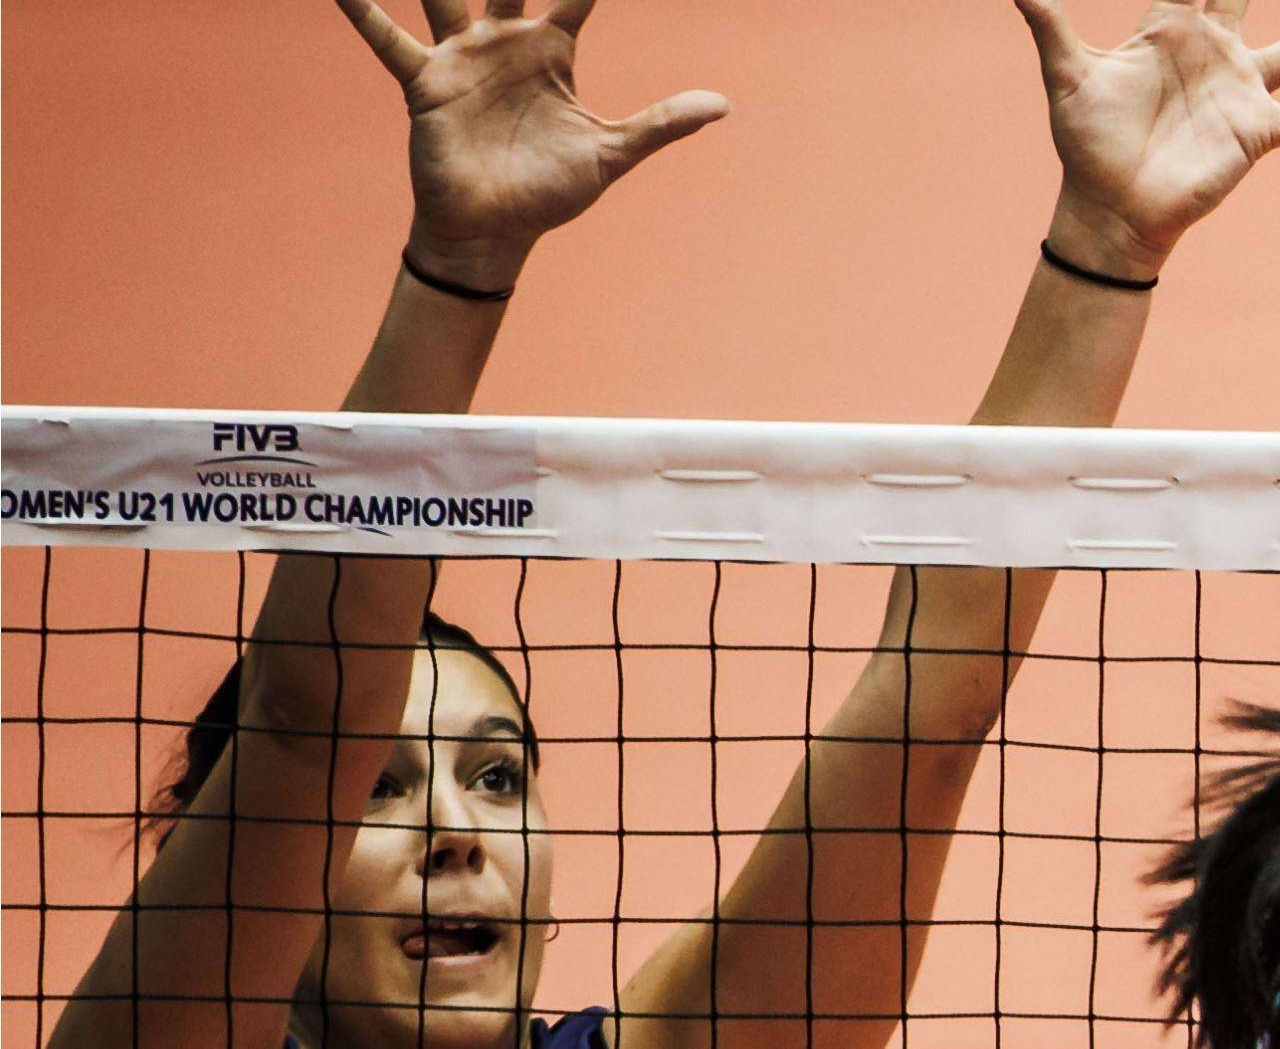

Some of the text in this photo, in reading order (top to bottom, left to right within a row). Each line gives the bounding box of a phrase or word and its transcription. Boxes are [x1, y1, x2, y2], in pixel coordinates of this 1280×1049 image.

[212, 422, 300, 452] FIVB
[196, 471, 317, 489] VOLLEYBALL
[0, 488, 534, 528] OMEN'S U21 WORLD CHAMPIONSHIP
